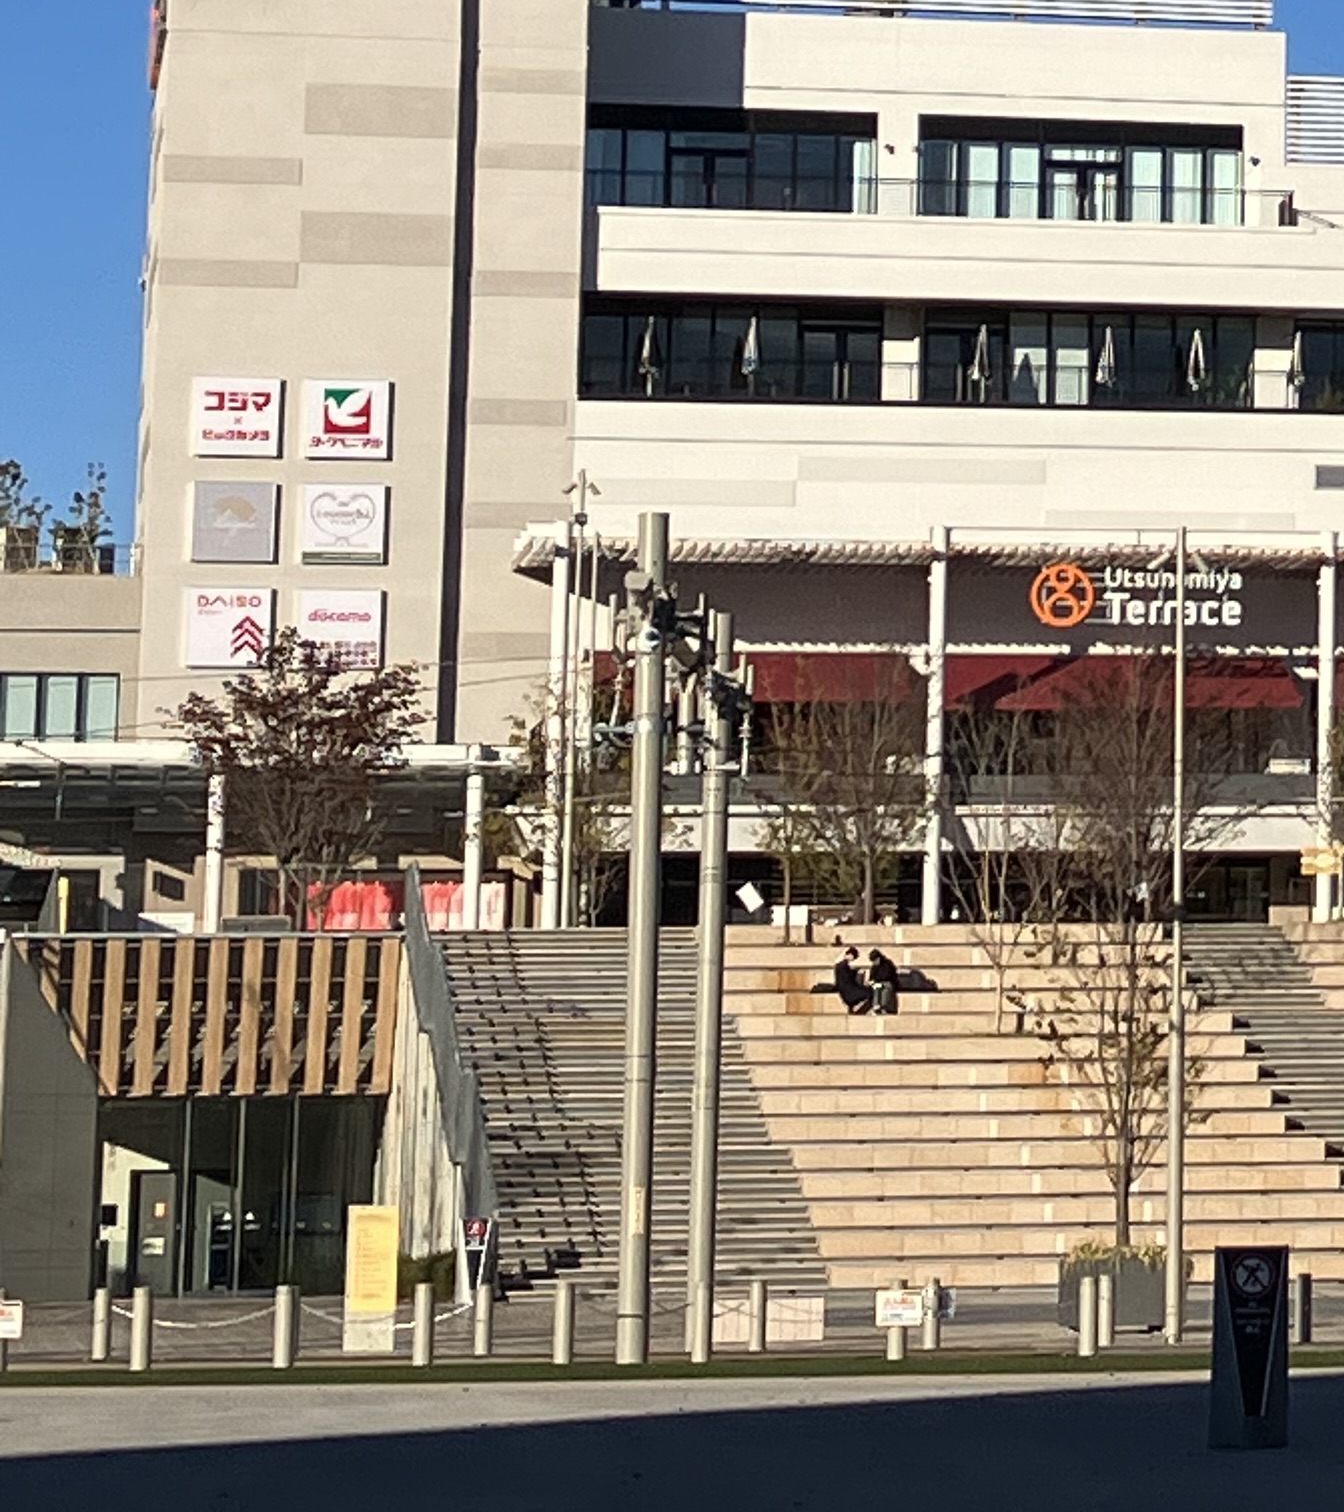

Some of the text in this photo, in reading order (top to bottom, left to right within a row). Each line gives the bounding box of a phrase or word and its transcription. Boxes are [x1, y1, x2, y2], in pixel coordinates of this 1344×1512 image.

[203, 390, 272, 412] コジマ
[197, 594, 262, 608] DAISO
[308, 608, 372, 622] docomo
